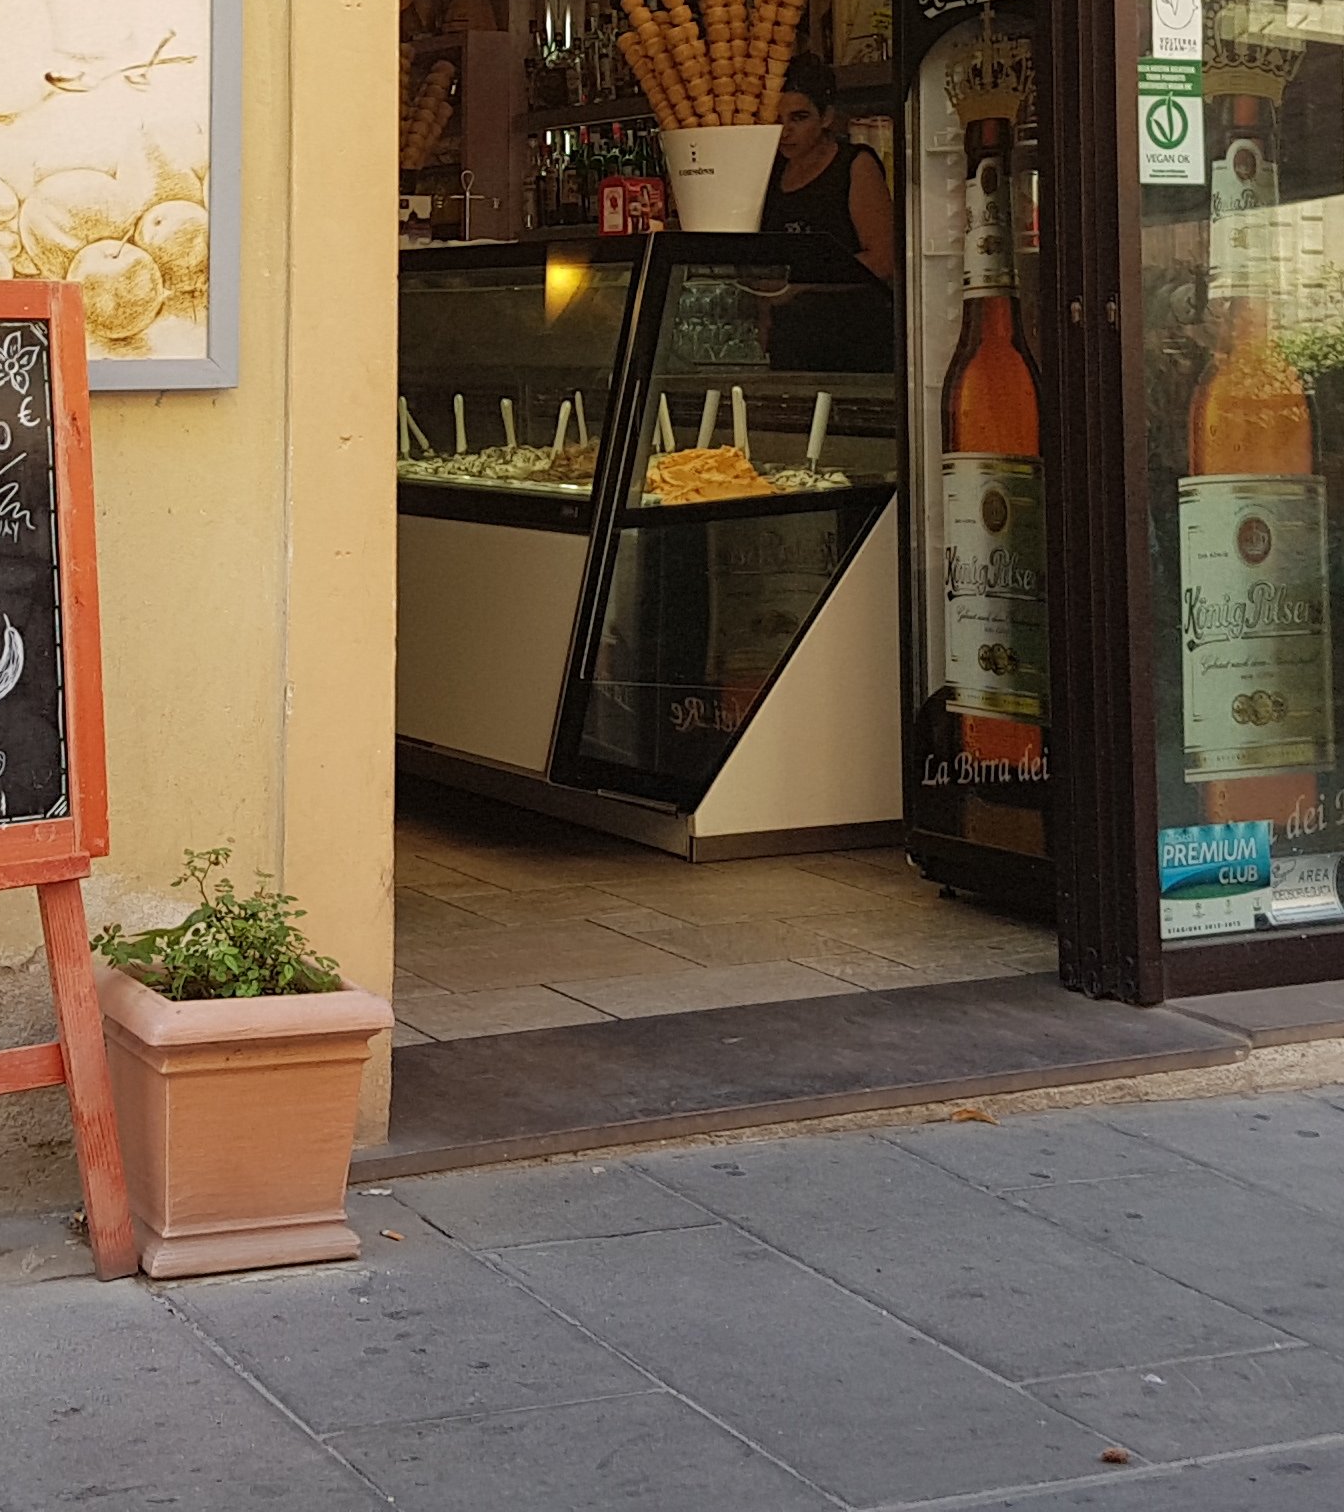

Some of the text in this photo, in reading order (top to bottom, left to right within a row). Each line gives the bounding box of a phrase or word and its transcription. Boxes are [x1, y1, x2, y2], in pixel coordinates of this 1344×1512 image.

[1146, 154, 1175, 163] VEGAN
[921, 743, 1050, 786] La Birra dei
[1286, 795, 1327, 840] dei
[1163, 837, 1257, 868] PREMIUM
[1218, 864, 1259, 885] CLUB
[1298, 868, 1330, 884] AREA
